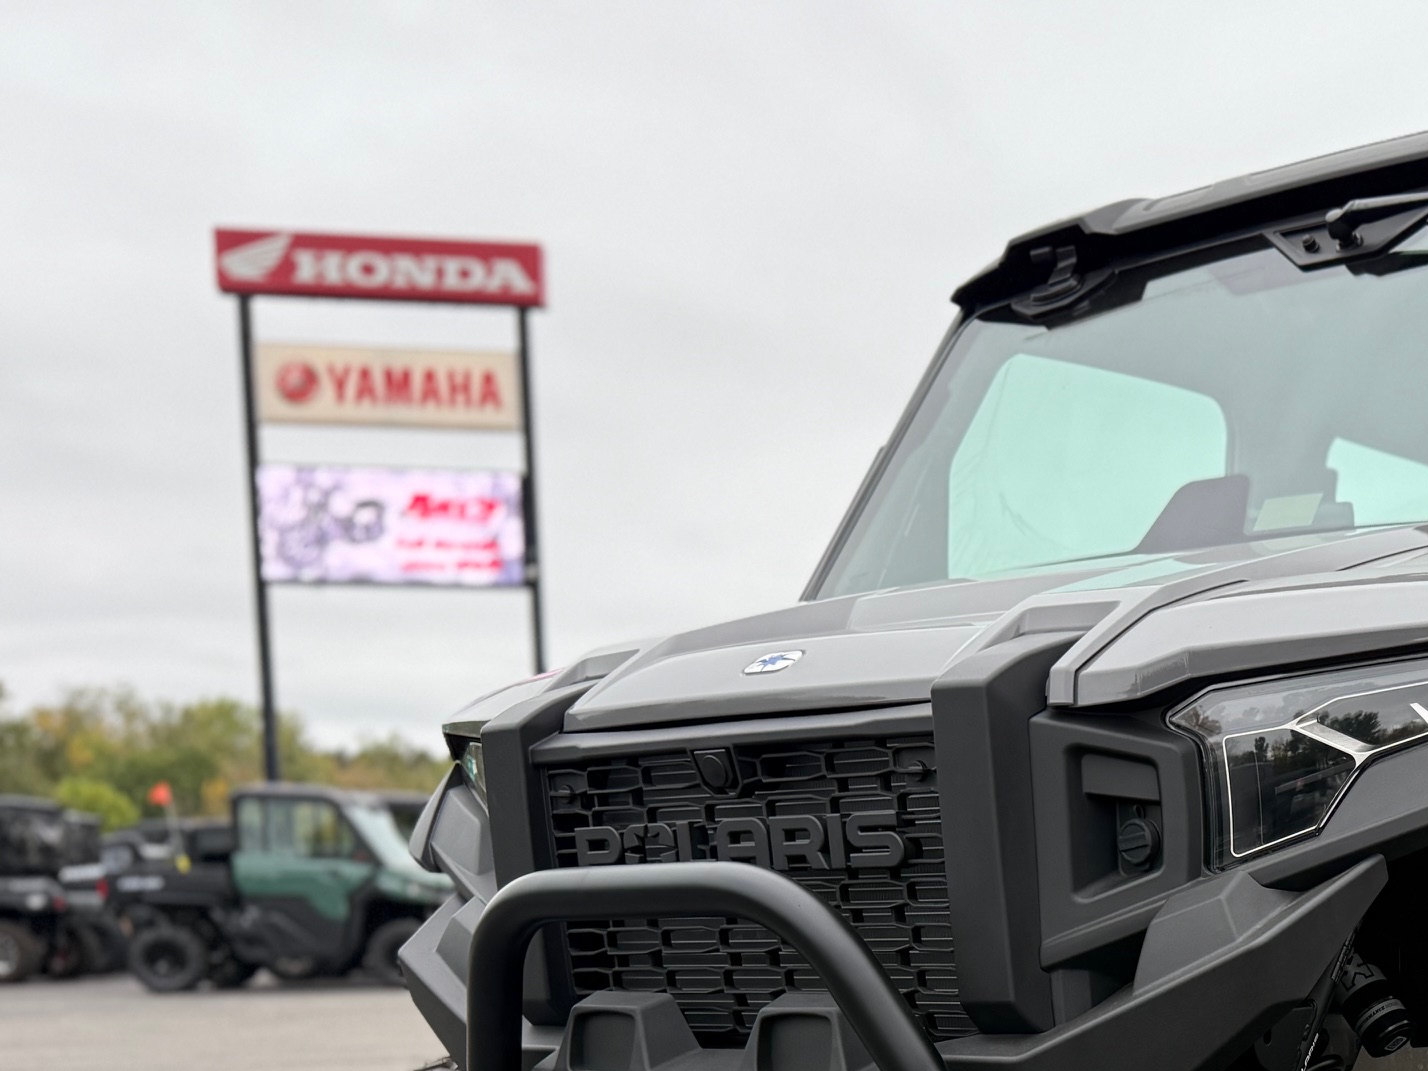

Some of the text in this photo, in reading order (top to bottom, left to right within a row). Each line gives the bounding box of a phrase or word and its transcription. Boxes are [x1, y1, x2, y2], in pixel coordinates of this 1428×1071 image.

[291, 247, 536, 295] HONDA
[326, 362, 503, 409] YAMAHA
[574, 810, 906, 870] POLARIS
